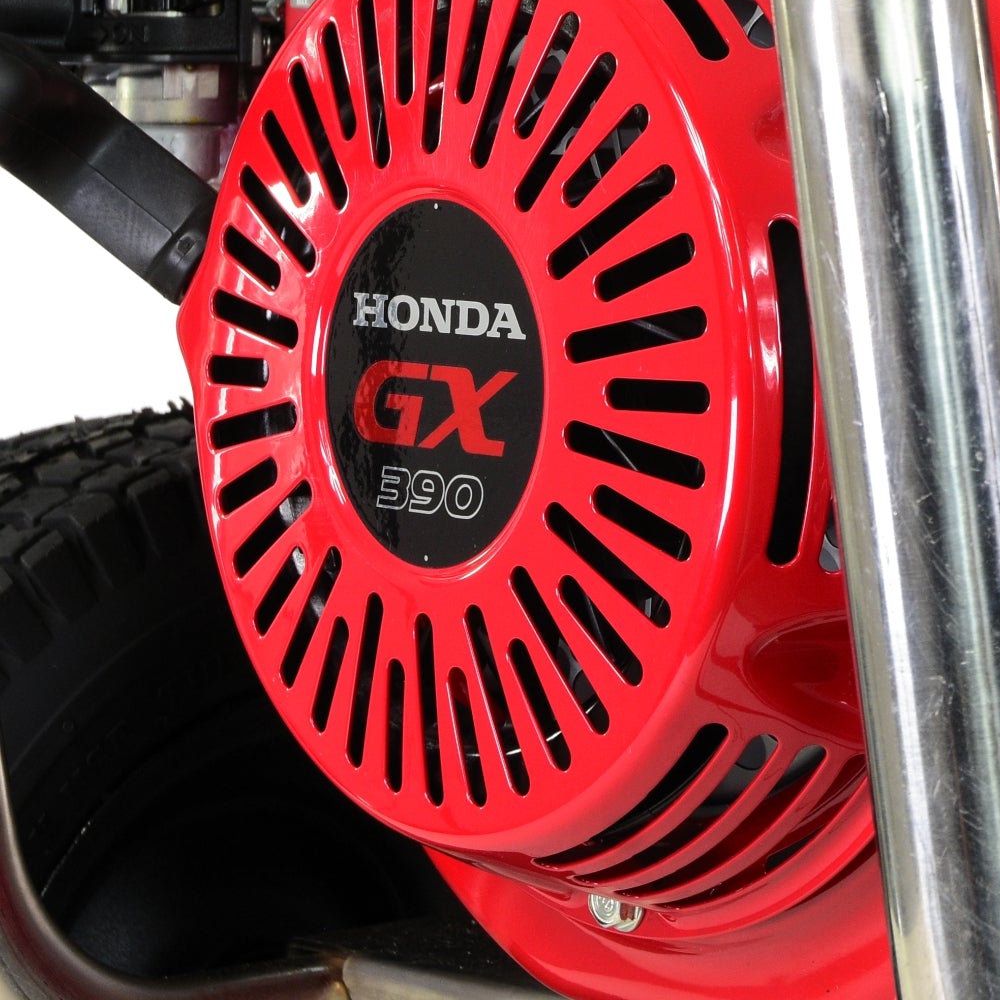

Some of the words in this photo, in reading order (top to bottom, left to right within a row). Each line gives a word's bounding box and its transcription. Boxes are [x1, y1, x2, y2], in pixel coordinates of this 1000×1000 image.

[352, 292, 526, 340] HONDA
[353, 359, 518, 457] GX
[376, 465, 484, 520] 390
